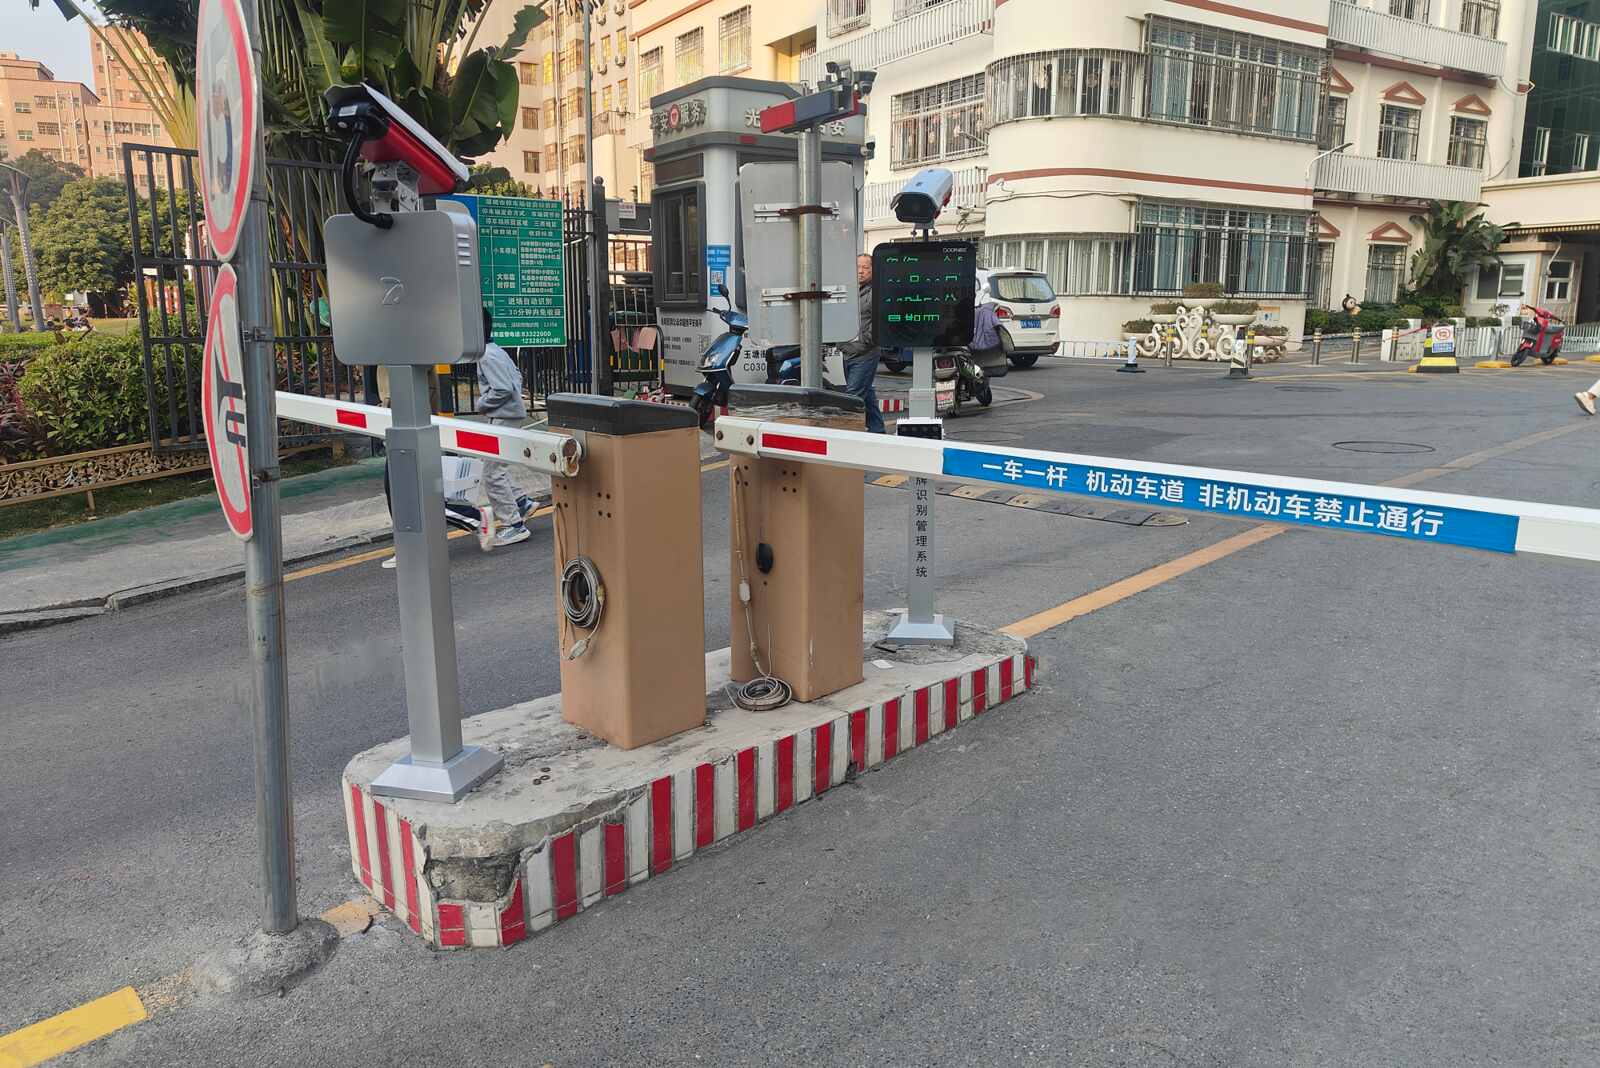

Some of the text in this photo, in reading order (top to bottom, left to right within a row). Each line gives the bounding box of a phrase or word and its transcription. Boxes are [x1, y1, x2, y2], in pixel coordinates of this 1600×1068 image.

[982, 459, 1445, 537] 一车一杆 机动车道 非机动车禁止通行
